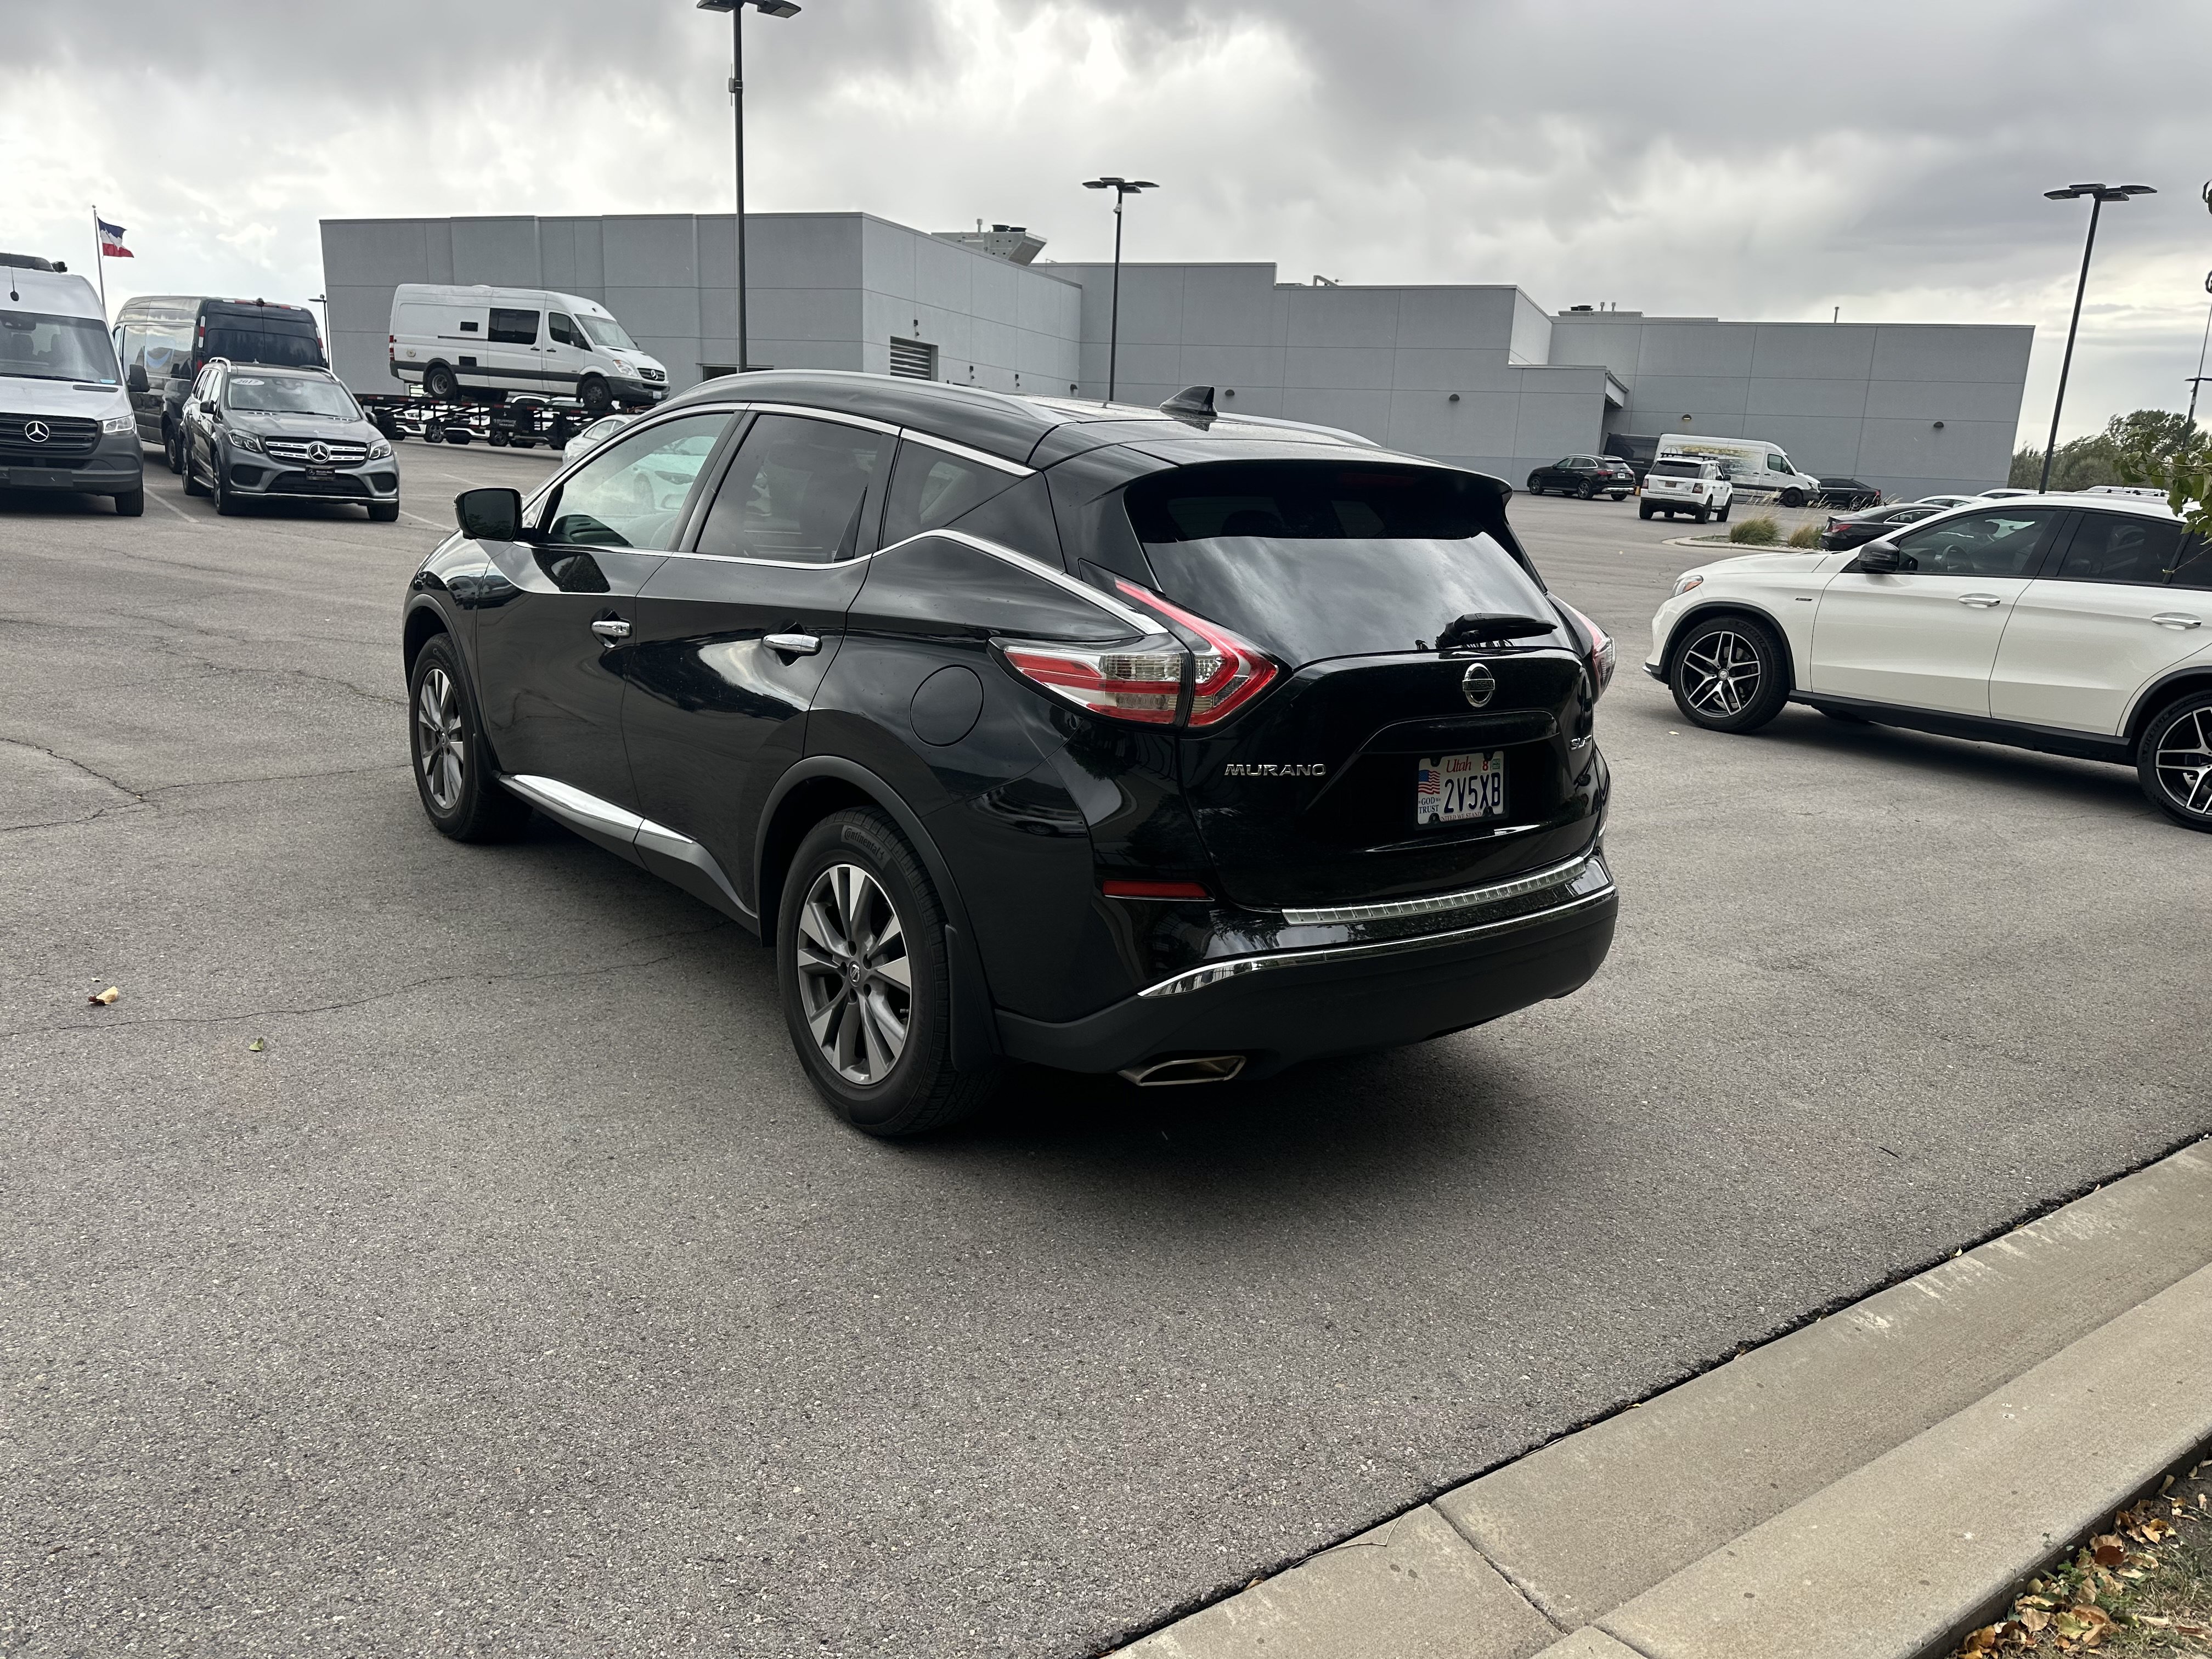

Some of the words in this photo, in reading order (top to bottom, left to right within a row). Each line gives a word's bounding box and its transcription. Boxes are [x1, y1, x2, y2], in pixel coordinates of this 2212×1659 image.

[1224, 764, 1326, 776] MURANO
[1447, 756, 1471, 772] Utah
[1482, 760, 1488, 771] 8
[1444, 772, 1500, 813] 2V5XB
[1421, 797, 1435, 805] GOD
[1419, 805, 1439, 814] TRUST
[844, 828, 881, 857] Continental
